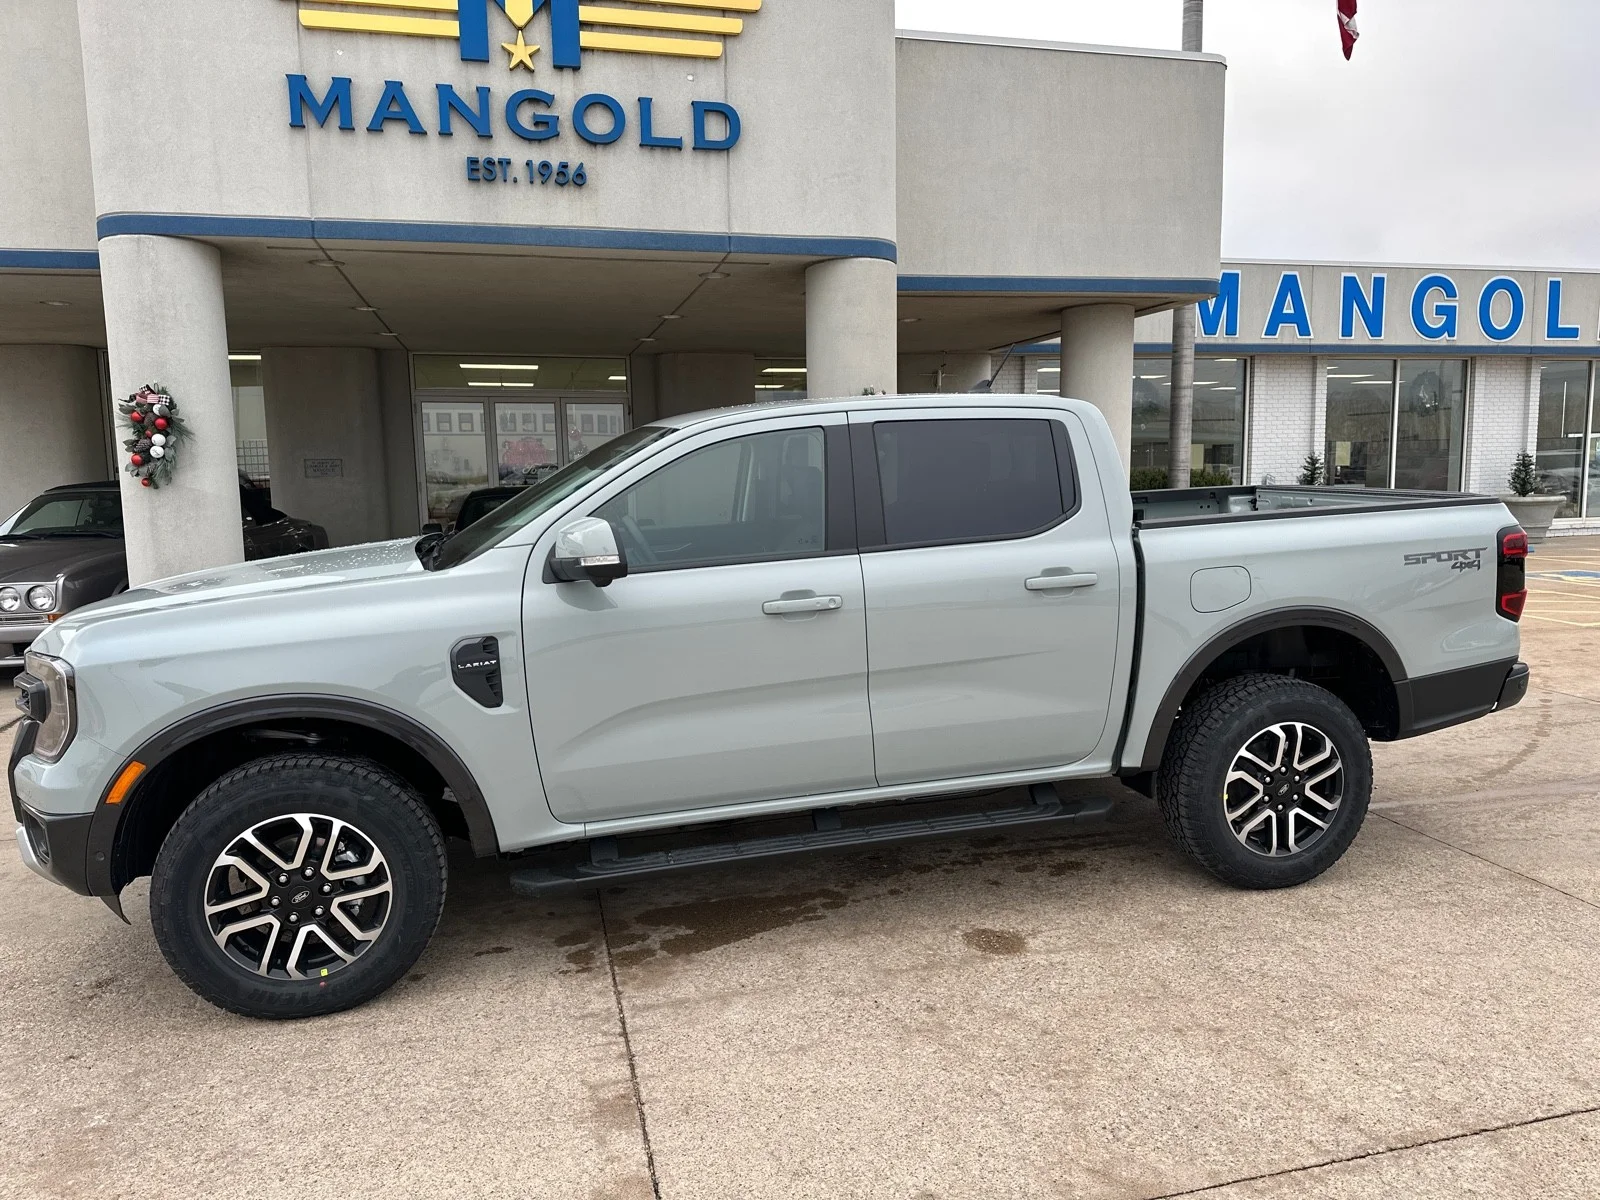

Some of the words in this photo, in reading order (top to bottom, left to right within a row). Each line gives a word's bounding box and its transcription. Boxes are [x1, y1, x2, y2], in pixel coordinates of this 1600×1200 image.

[285, 73, 741, 151] MANGOLD
[467, 156, 518, 183] EST.
[526, 159, 588, 187] 1956
[1195, 269, 1600, 341] MANGOL
[1403, 546, 1488, 566] SPORT
[1450, 559, 1481, 573] 4x4
[457, 659, 497, 670] LARIAT
